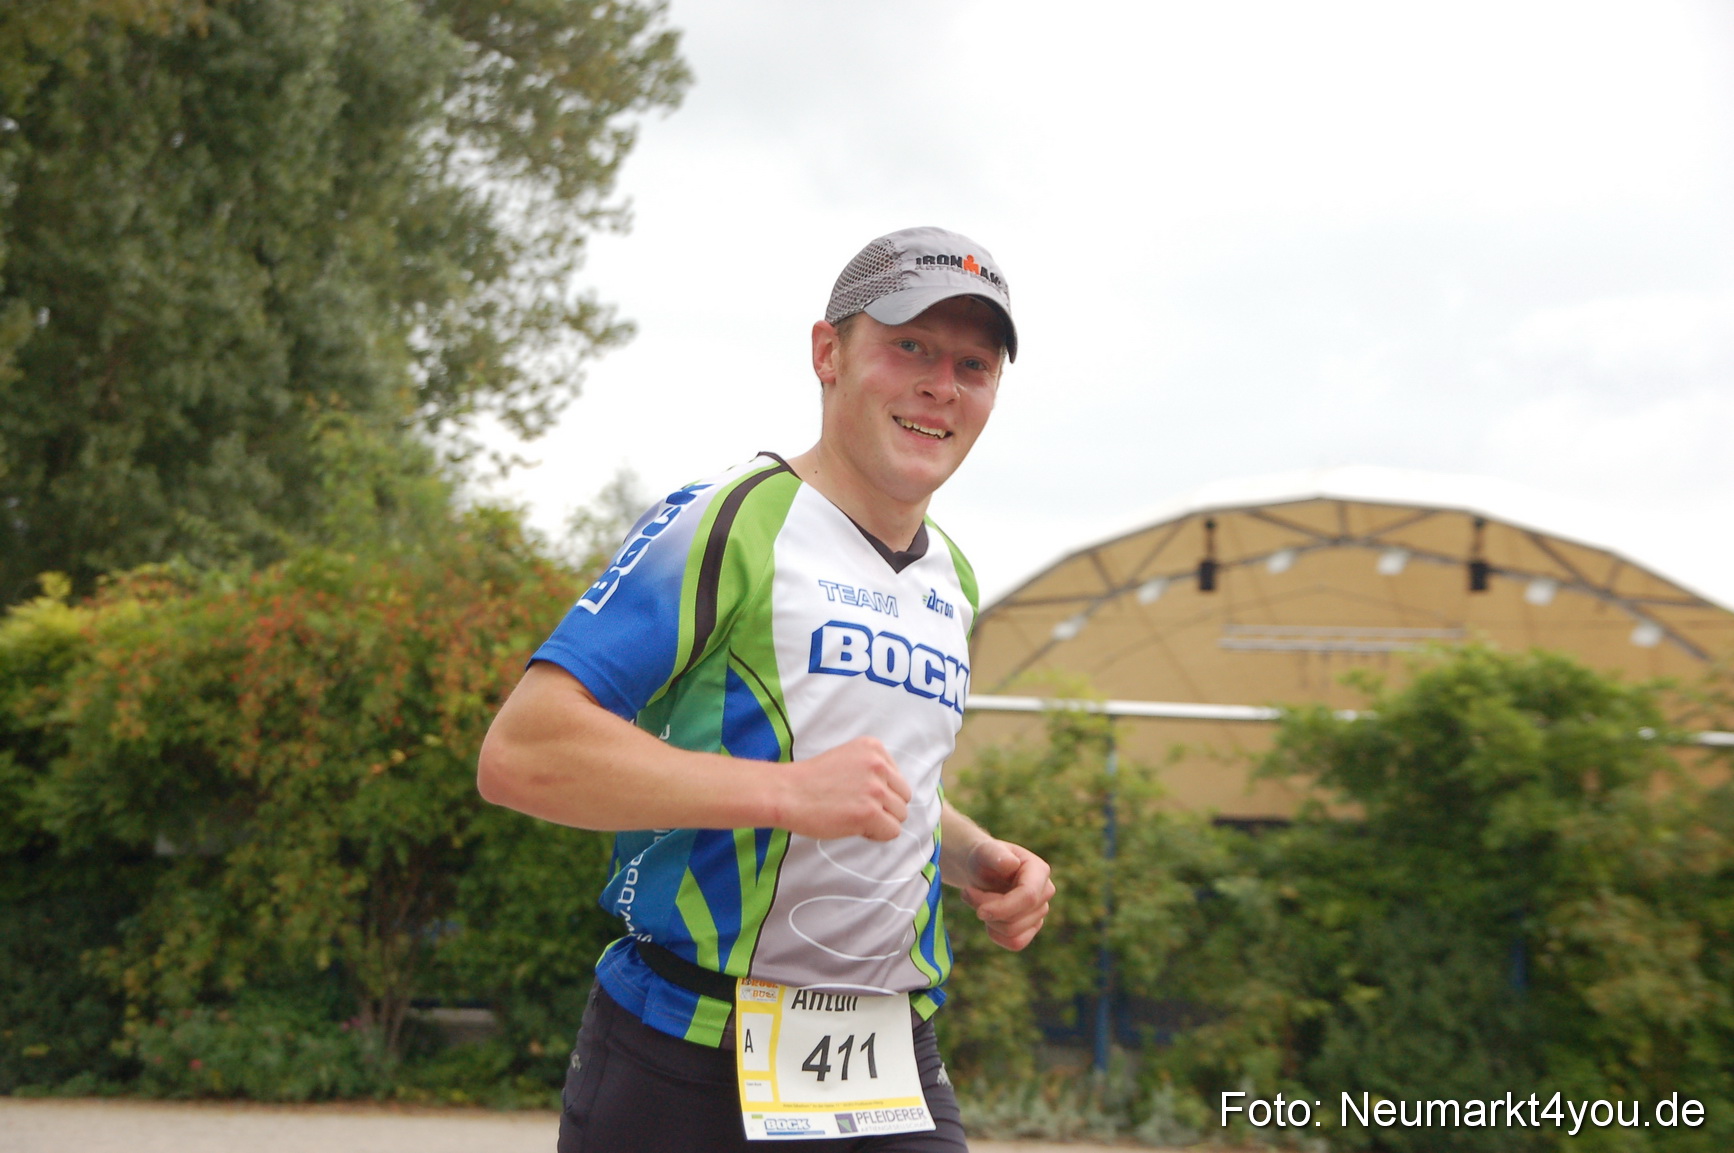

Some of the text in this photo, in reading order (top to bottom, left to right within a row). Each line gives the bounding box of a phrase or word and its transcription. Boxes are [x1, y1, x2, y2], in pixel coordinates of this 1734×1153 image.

[818, 579, 899, 617] TEAM
[808, 620, 970, 715] BOCK
[744, 1028, 754, 1053] A
[801, 1032, 878, 1082] 411
[764, 1118, 811, 1131] BOCK
[855, 1108, 927, 1124] PFLEIDERER
